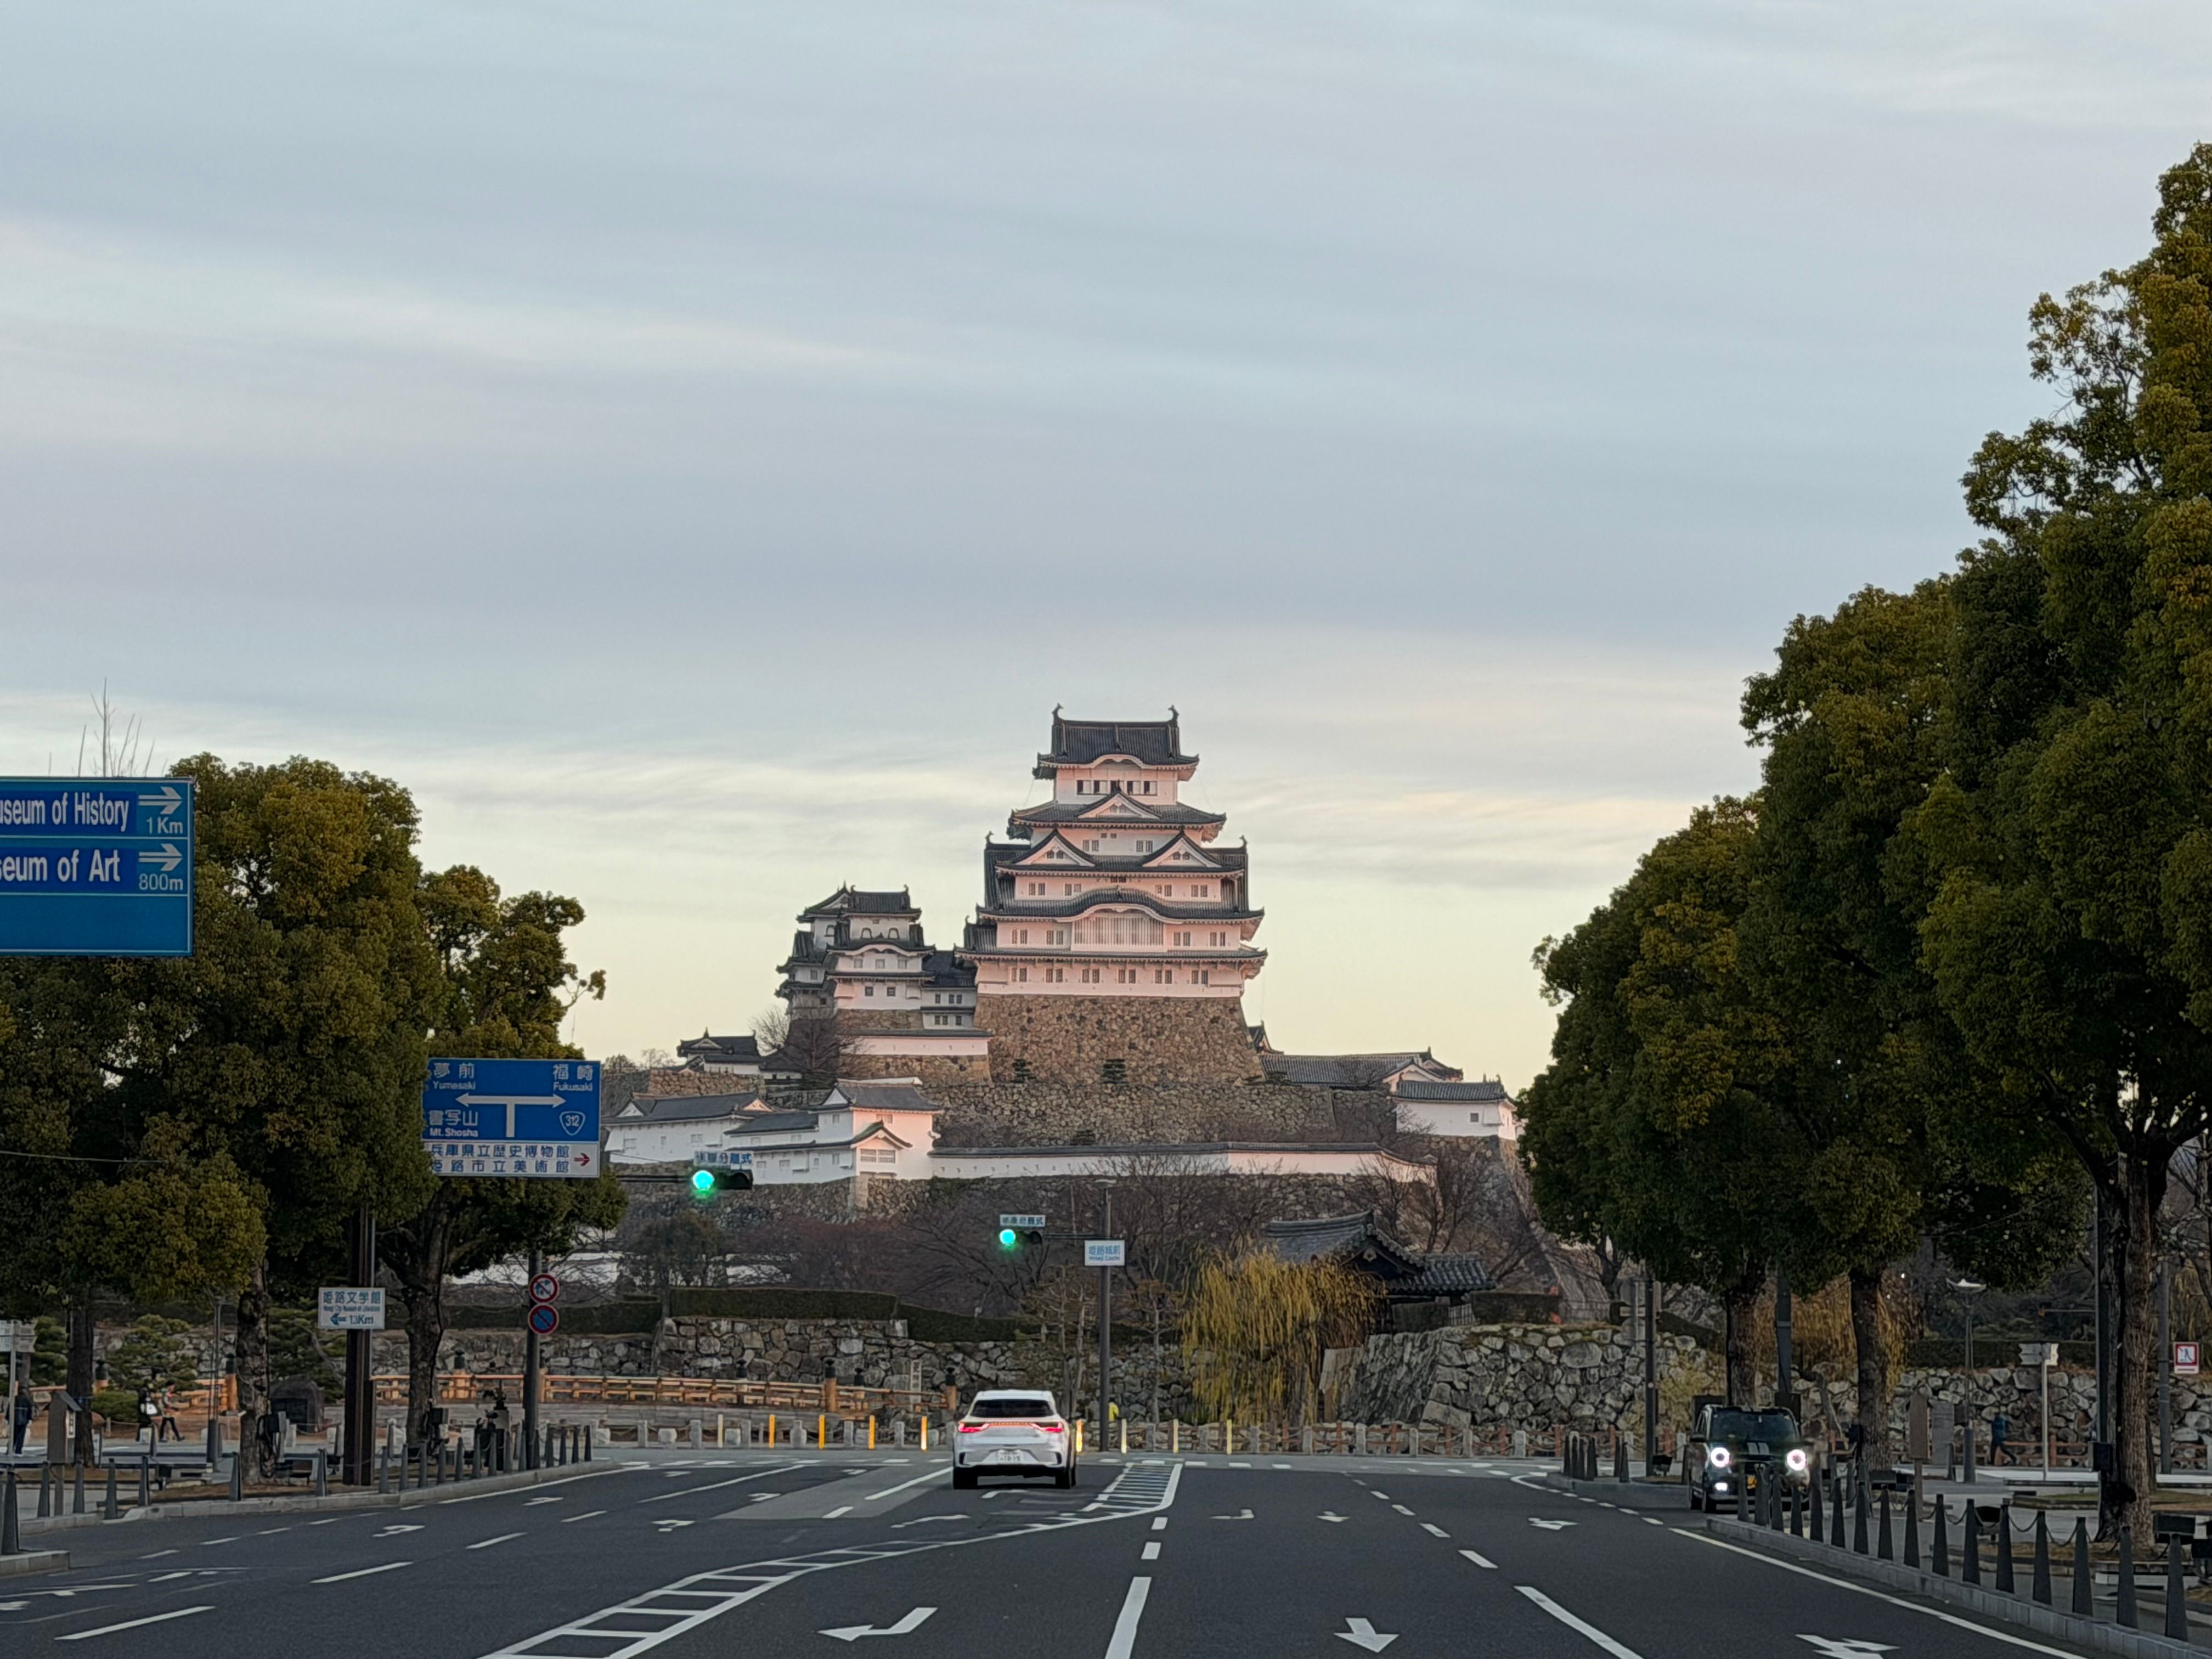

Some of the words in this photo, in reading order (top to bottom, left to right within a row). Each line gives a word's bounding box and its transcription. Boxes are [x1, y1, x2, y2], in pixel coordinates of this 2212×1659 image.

[52, 792, 68, 825] of
[75, 792, 129, 832] History
[0, 856, 48, 882] eum
[57, 849, 80, 882] of
[88, 849, 120, 882] Art
[138, 873, 184, 890] 800m
[433, 1062, 475, 1079] 夢前
[553, 1081, 593, 1092] Fukusaki
[428, 1109, 478, 1126] 書写山
[565, 1115, 580, 1127] 312
[323, 1291, 381, 1304] 姫路文学館
